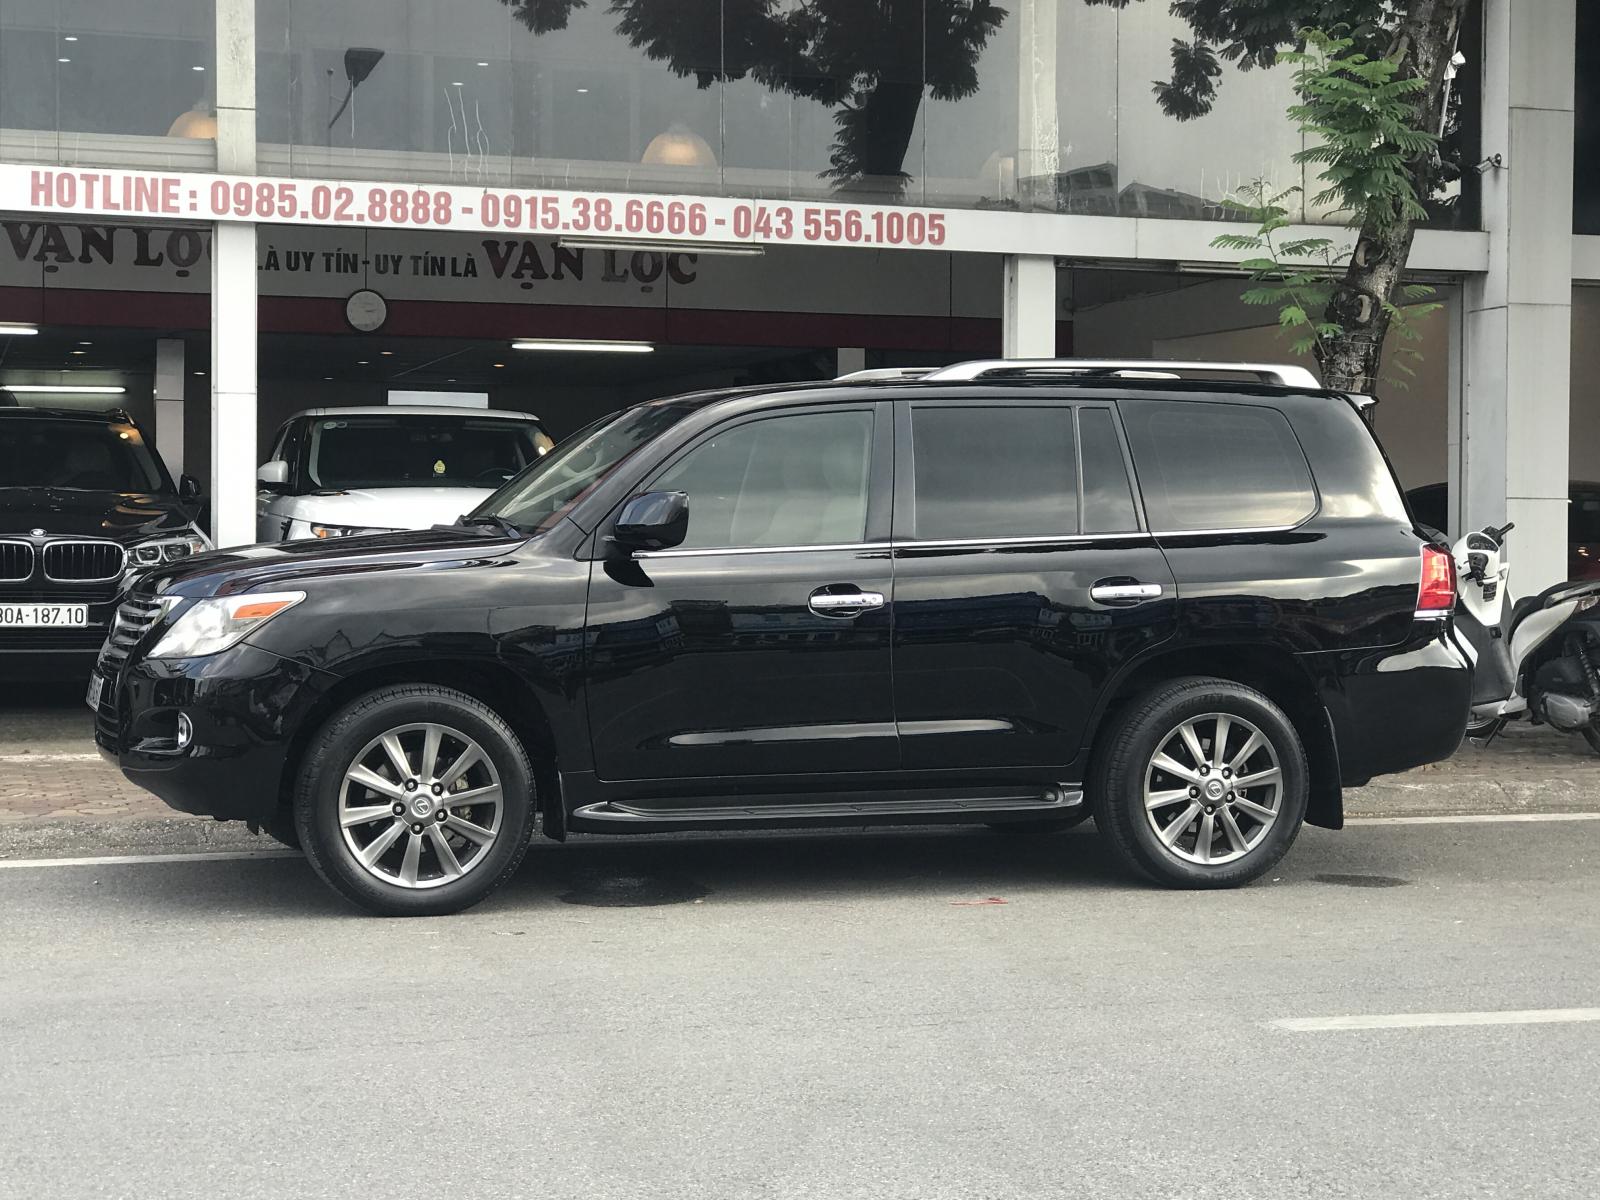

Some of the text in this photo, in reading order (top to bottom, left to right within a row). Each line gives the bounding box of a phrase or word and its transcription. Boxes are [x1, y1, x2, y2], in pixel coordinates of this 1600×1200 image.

[210, 181, 452, 225] 0985.02.8888
[480, 193, 707, 236] 0915.38.6666
[733, 204, 794, 240] 043
[803, 207, 945, 246] 556.1005
[133, 228, 212, 278] LỌ
[286, 250, 315, 272] UY
[322, 247, 359, 274] TÍN
[375, 254, 403, 275] UY
[410, 251, 446, 277] TÍN
[451, 252, 478, 278] LÀ
[481, 239, 584, 290] VẠN
[601, 249, 698, 294] LỌC
